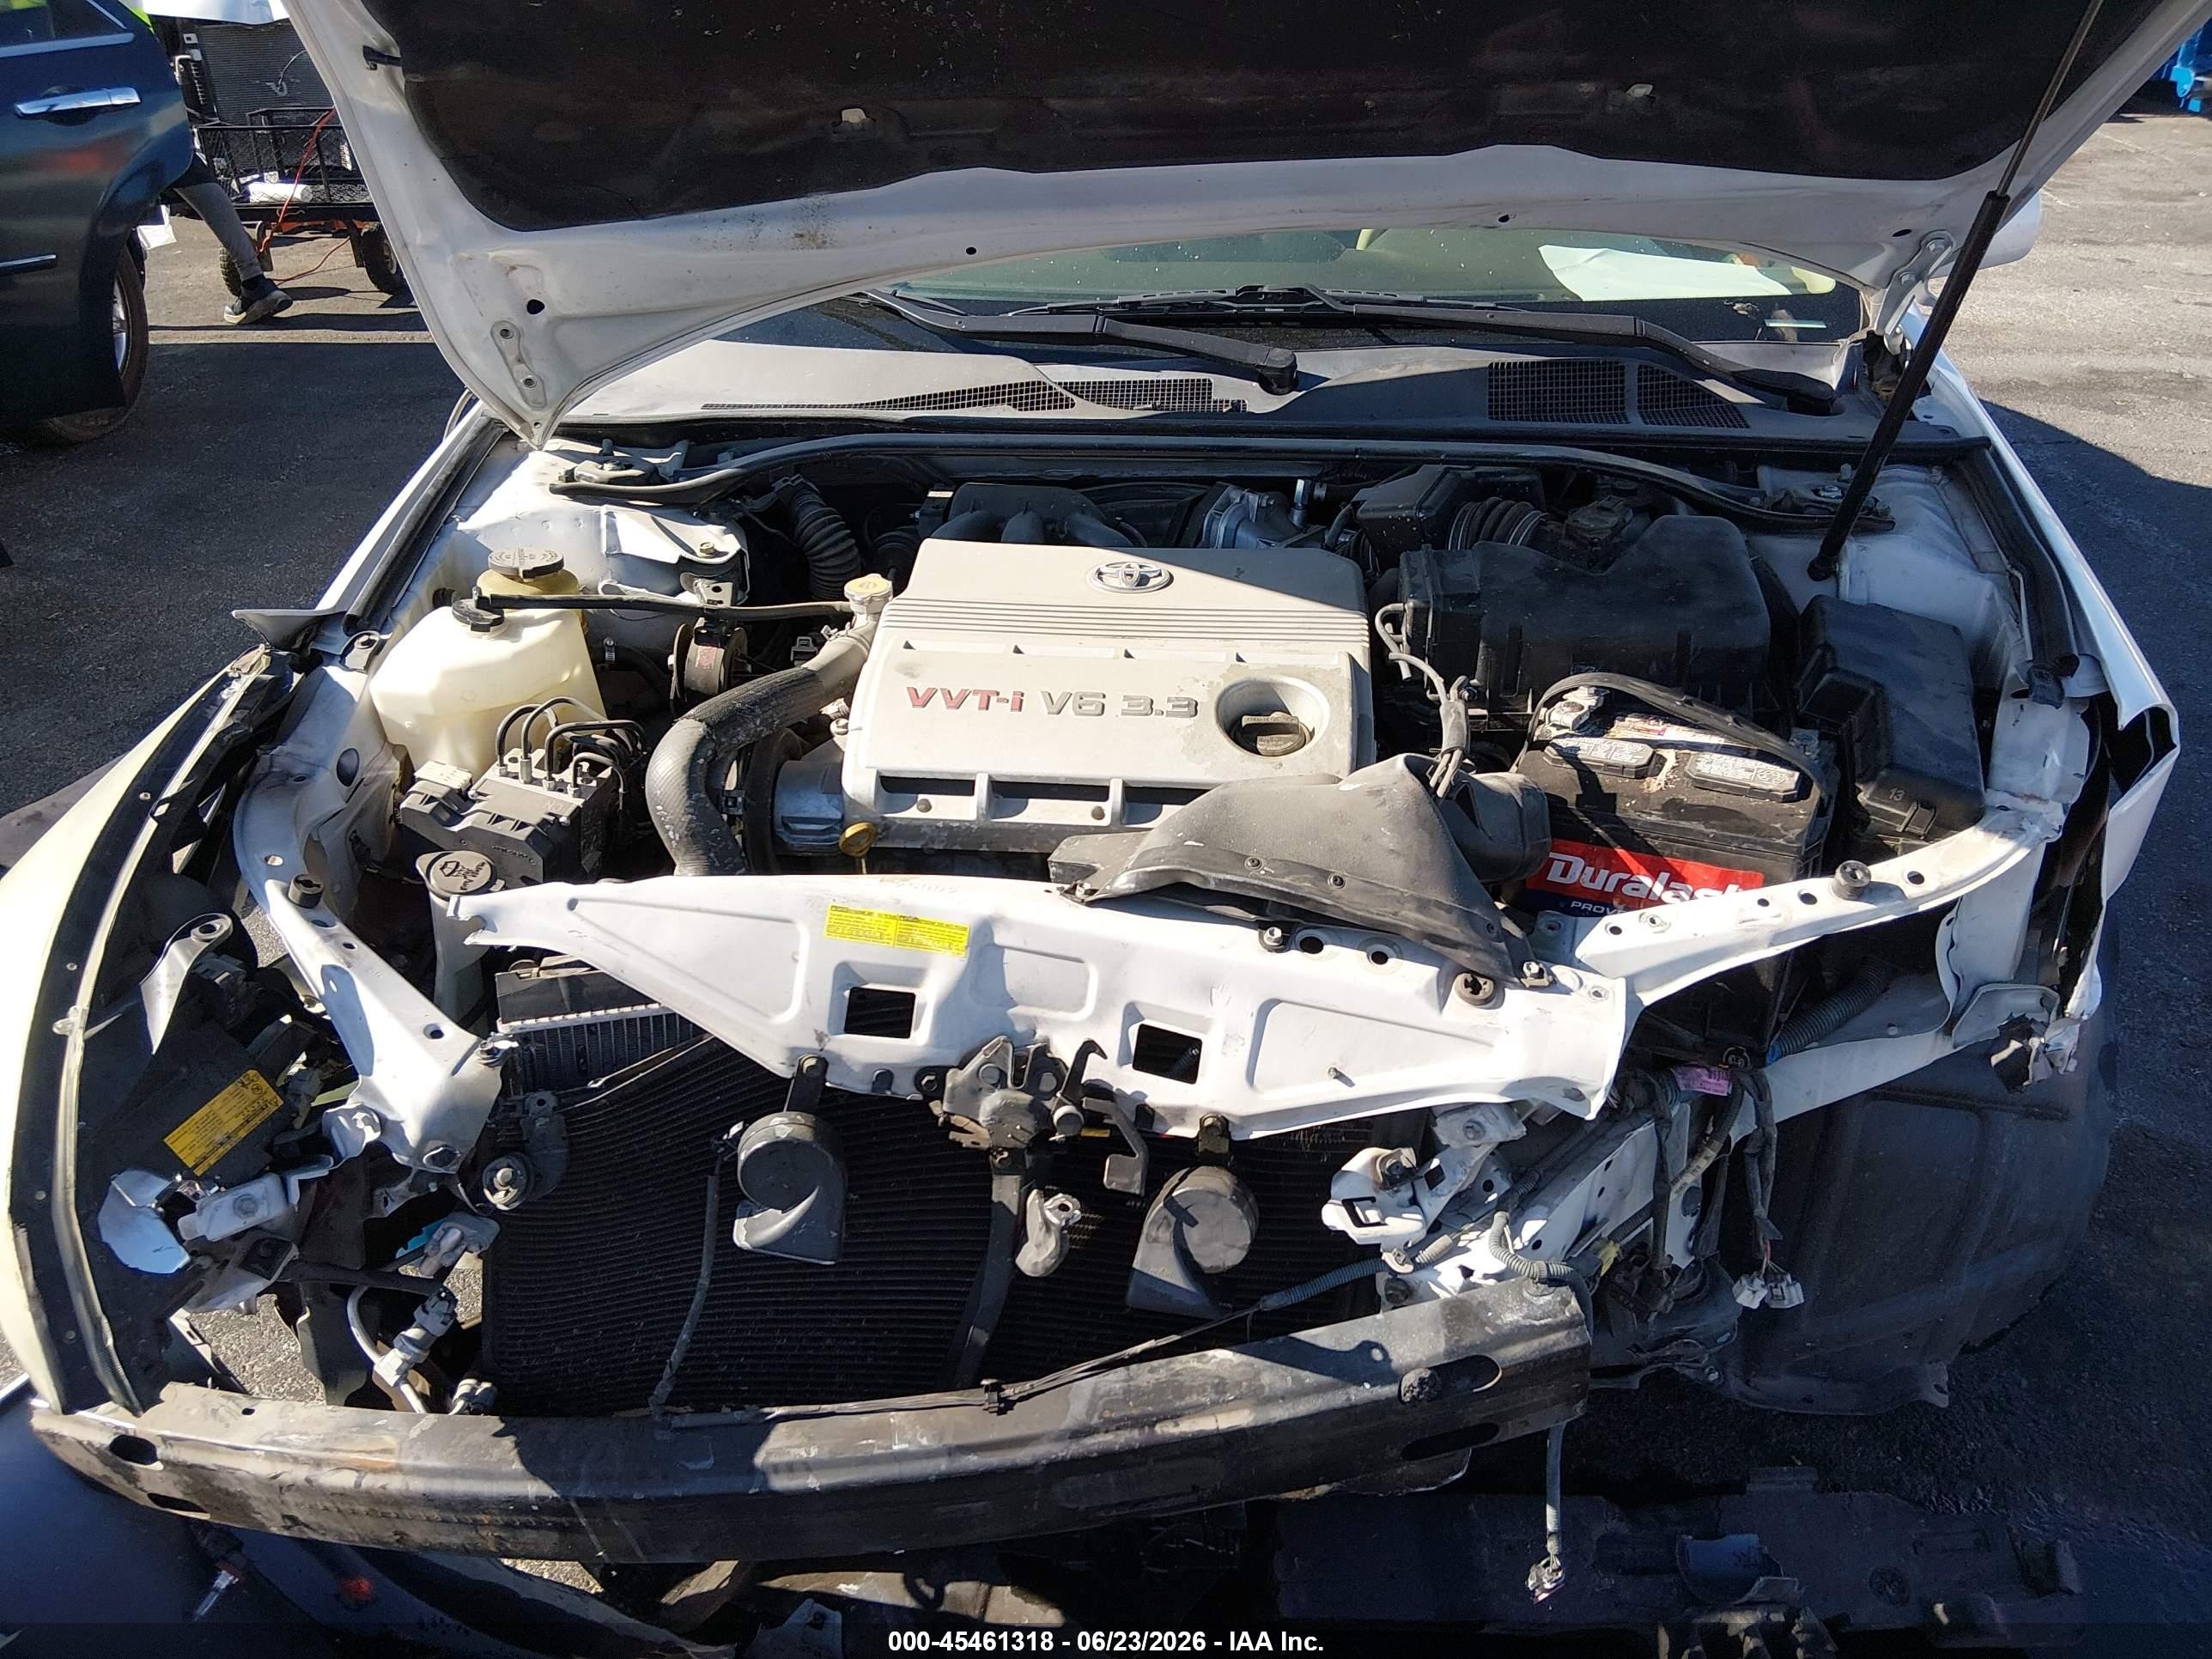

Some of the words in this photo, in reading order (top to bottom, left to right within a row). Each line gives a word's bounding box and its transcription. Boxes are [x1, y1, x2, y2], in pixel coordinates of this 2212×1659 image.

[906, 686, 1024, 712] VVT-i
[1040, 690, 1107, 717] V6
[1120, 695, 1199, 719] 3.3
[1888, 787, 1905, 801] 13
[1571, 901, 1627, 915] PROV
